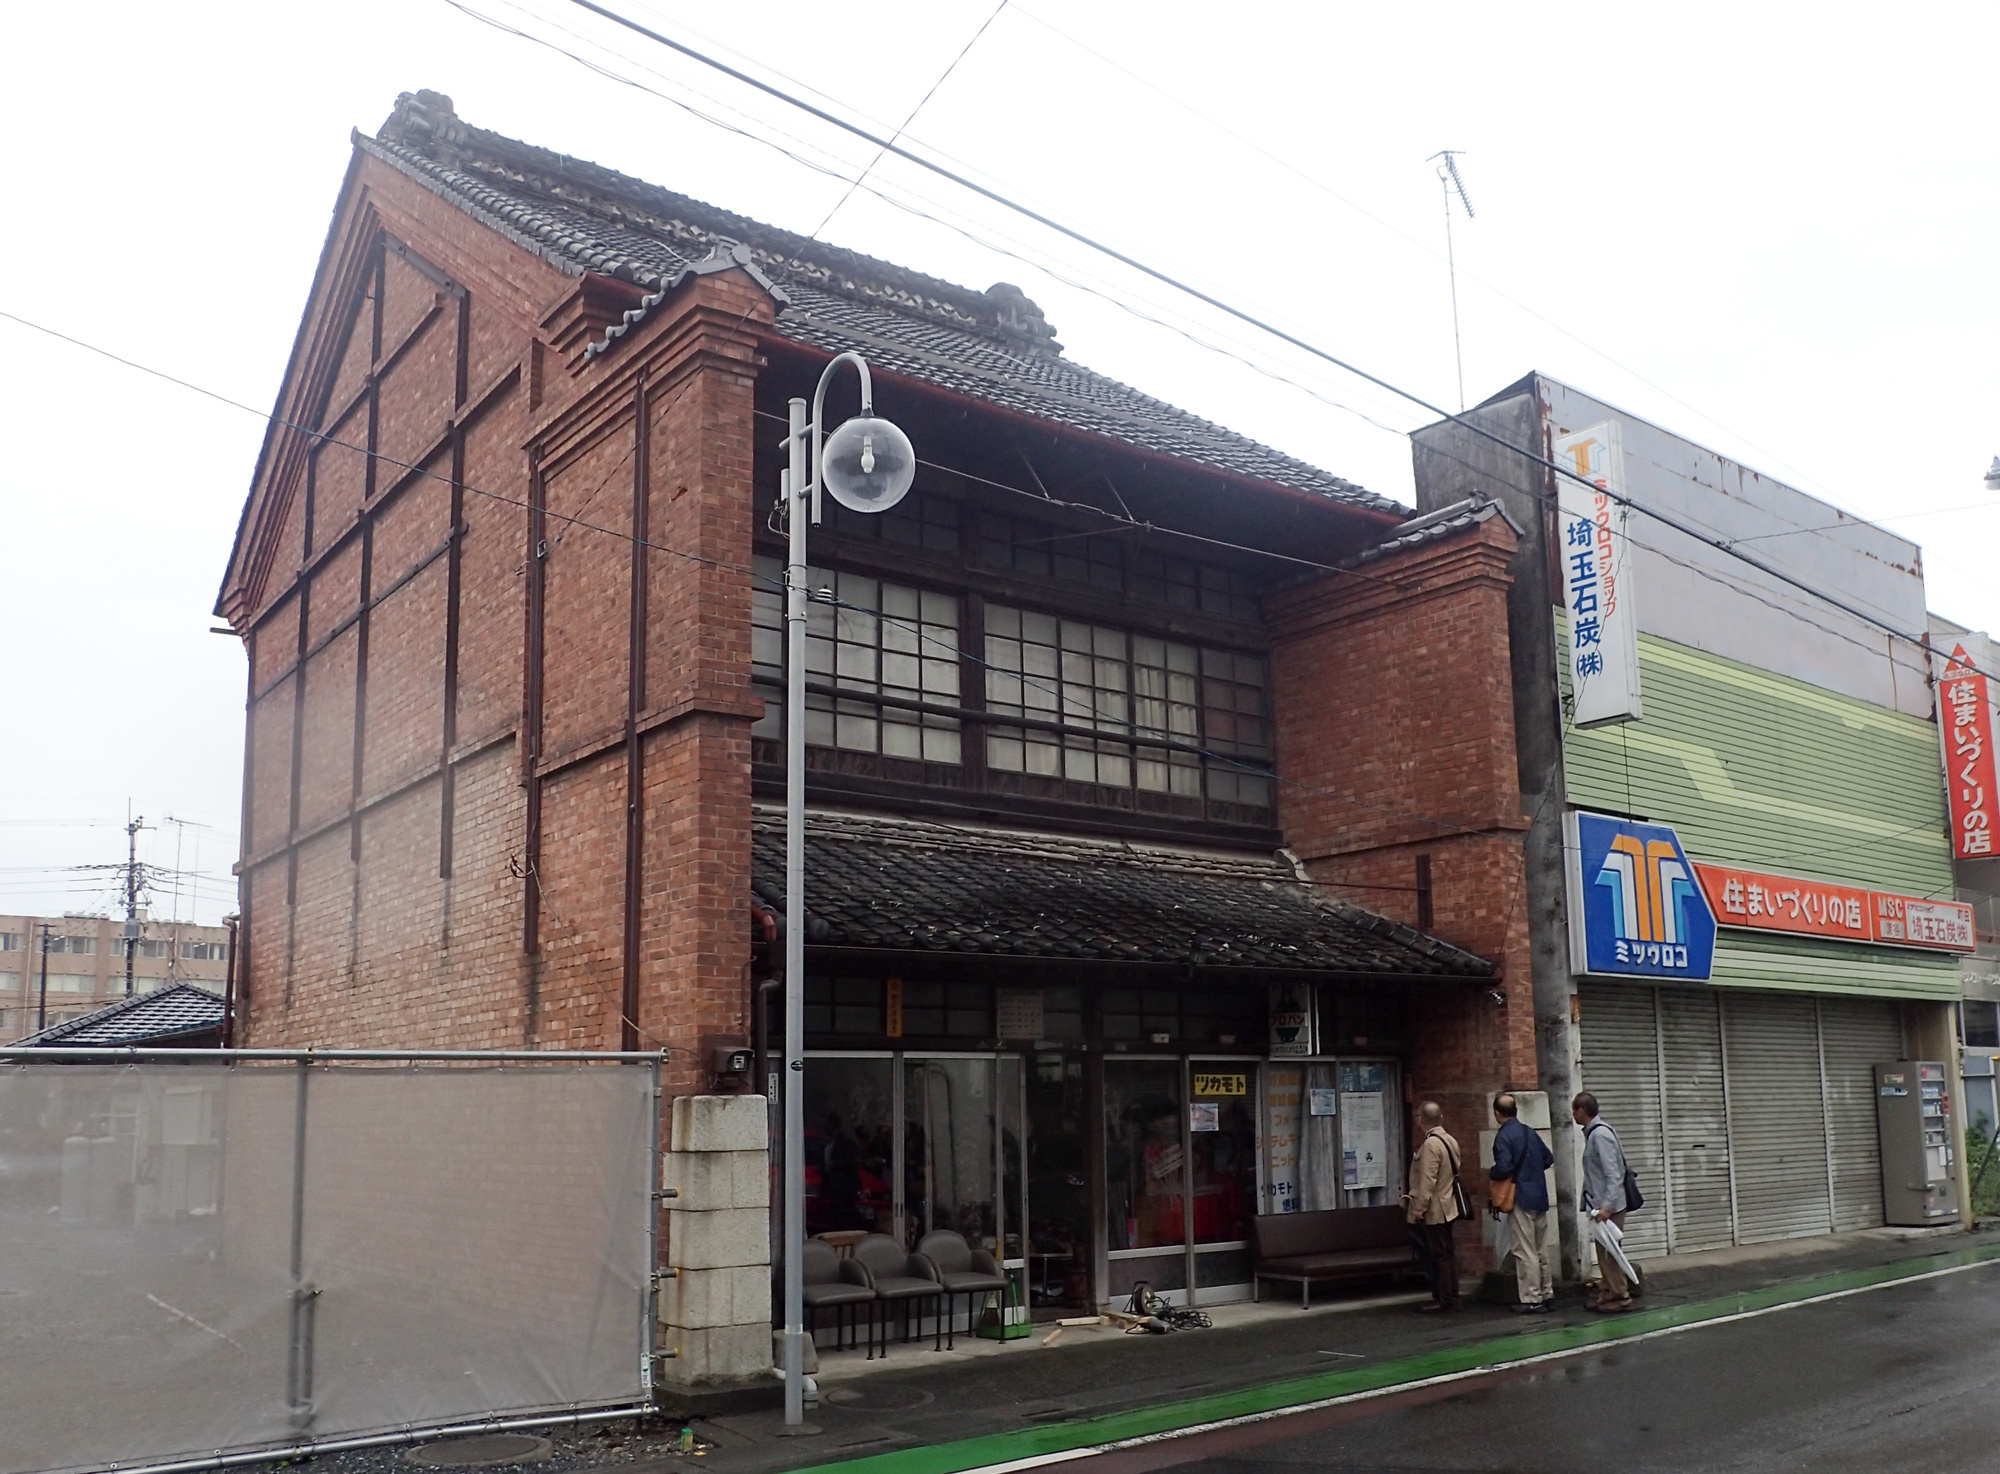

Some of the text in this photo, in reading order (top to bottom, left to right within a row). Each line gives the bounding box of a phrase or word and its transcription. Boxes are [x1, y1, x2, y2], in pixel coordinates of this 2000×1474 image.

[1594, 479, 1618, 618] ミツウロコショップ
[1567, 518, 1603, 682] 埼玉石炭(株)
[1947, 681, 1992, 855] 住まいづくりの店
[1721, 877, 1862, 930] 住まいづくりの店
[1878, 896, 1903, 919] MSC
[1615, 939, 1688, 968] ミツウロコ
[1196, 1076, 1245, 1093] ツカモト
